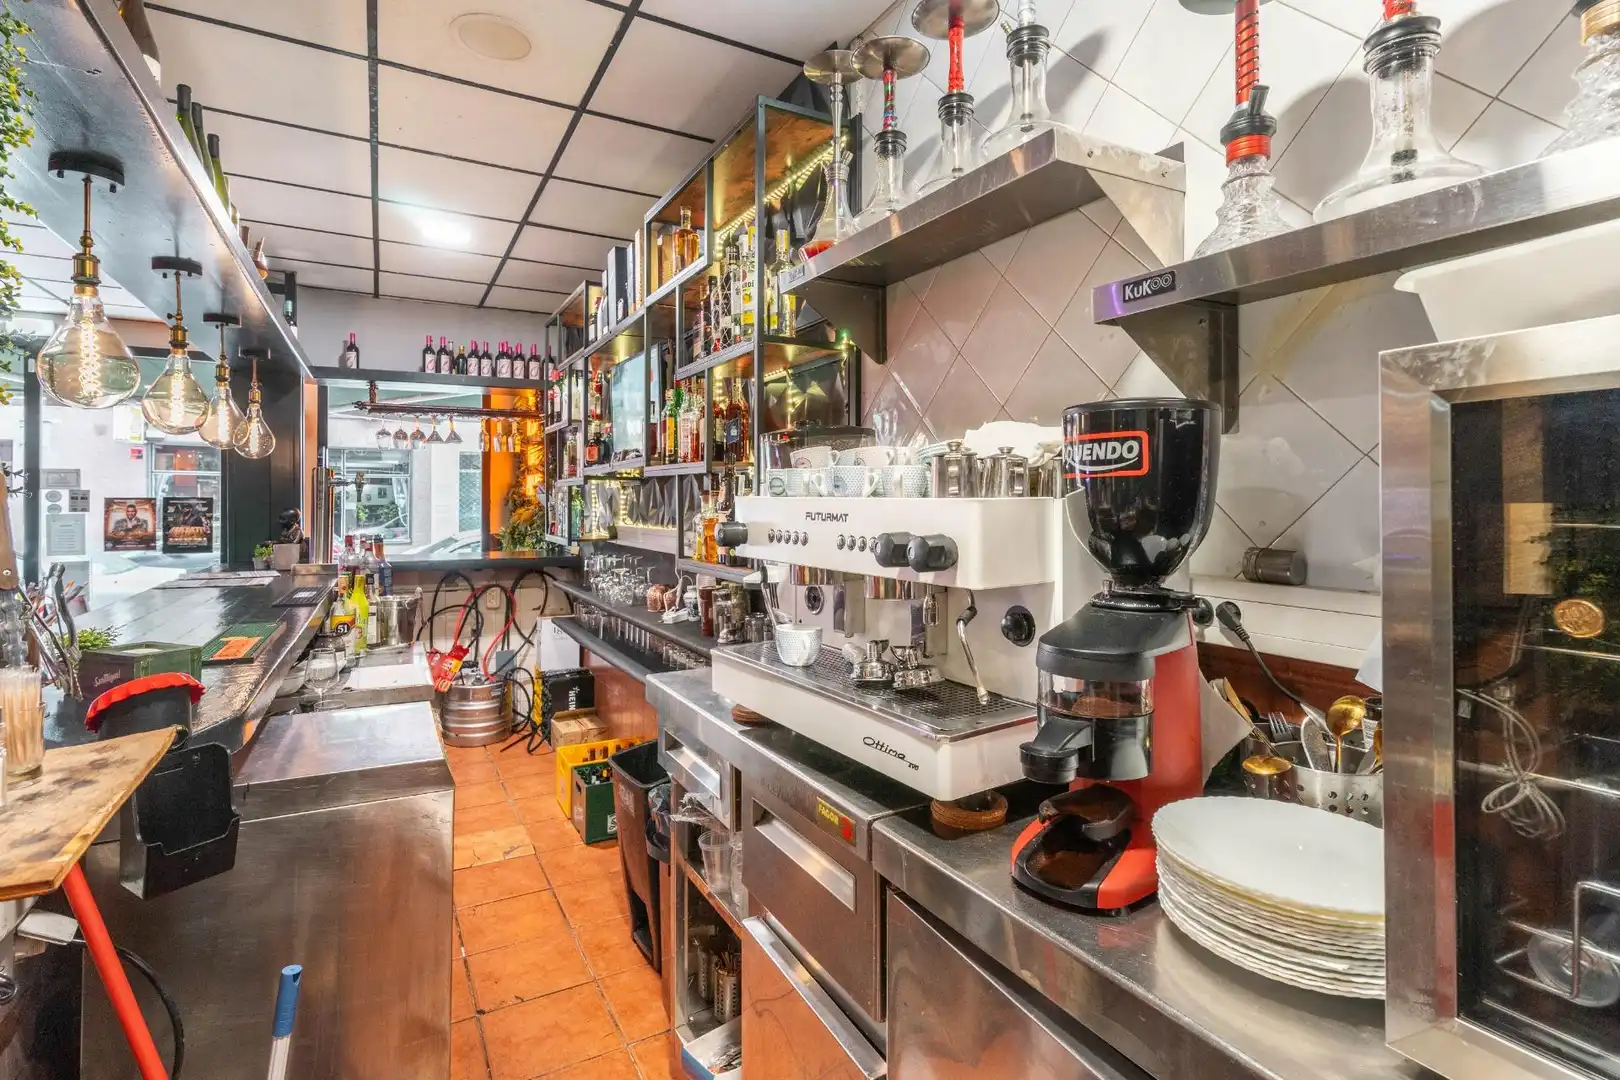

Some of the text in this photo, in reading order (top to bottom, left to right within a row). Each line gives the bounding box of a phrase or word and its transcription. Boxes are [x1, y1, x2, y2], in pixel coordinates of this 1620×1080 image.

[805, 511, 849, 523] FUTURMAT
[337, 624, 348, 634] 51
[818, 803, 839, 825] FAGOR
